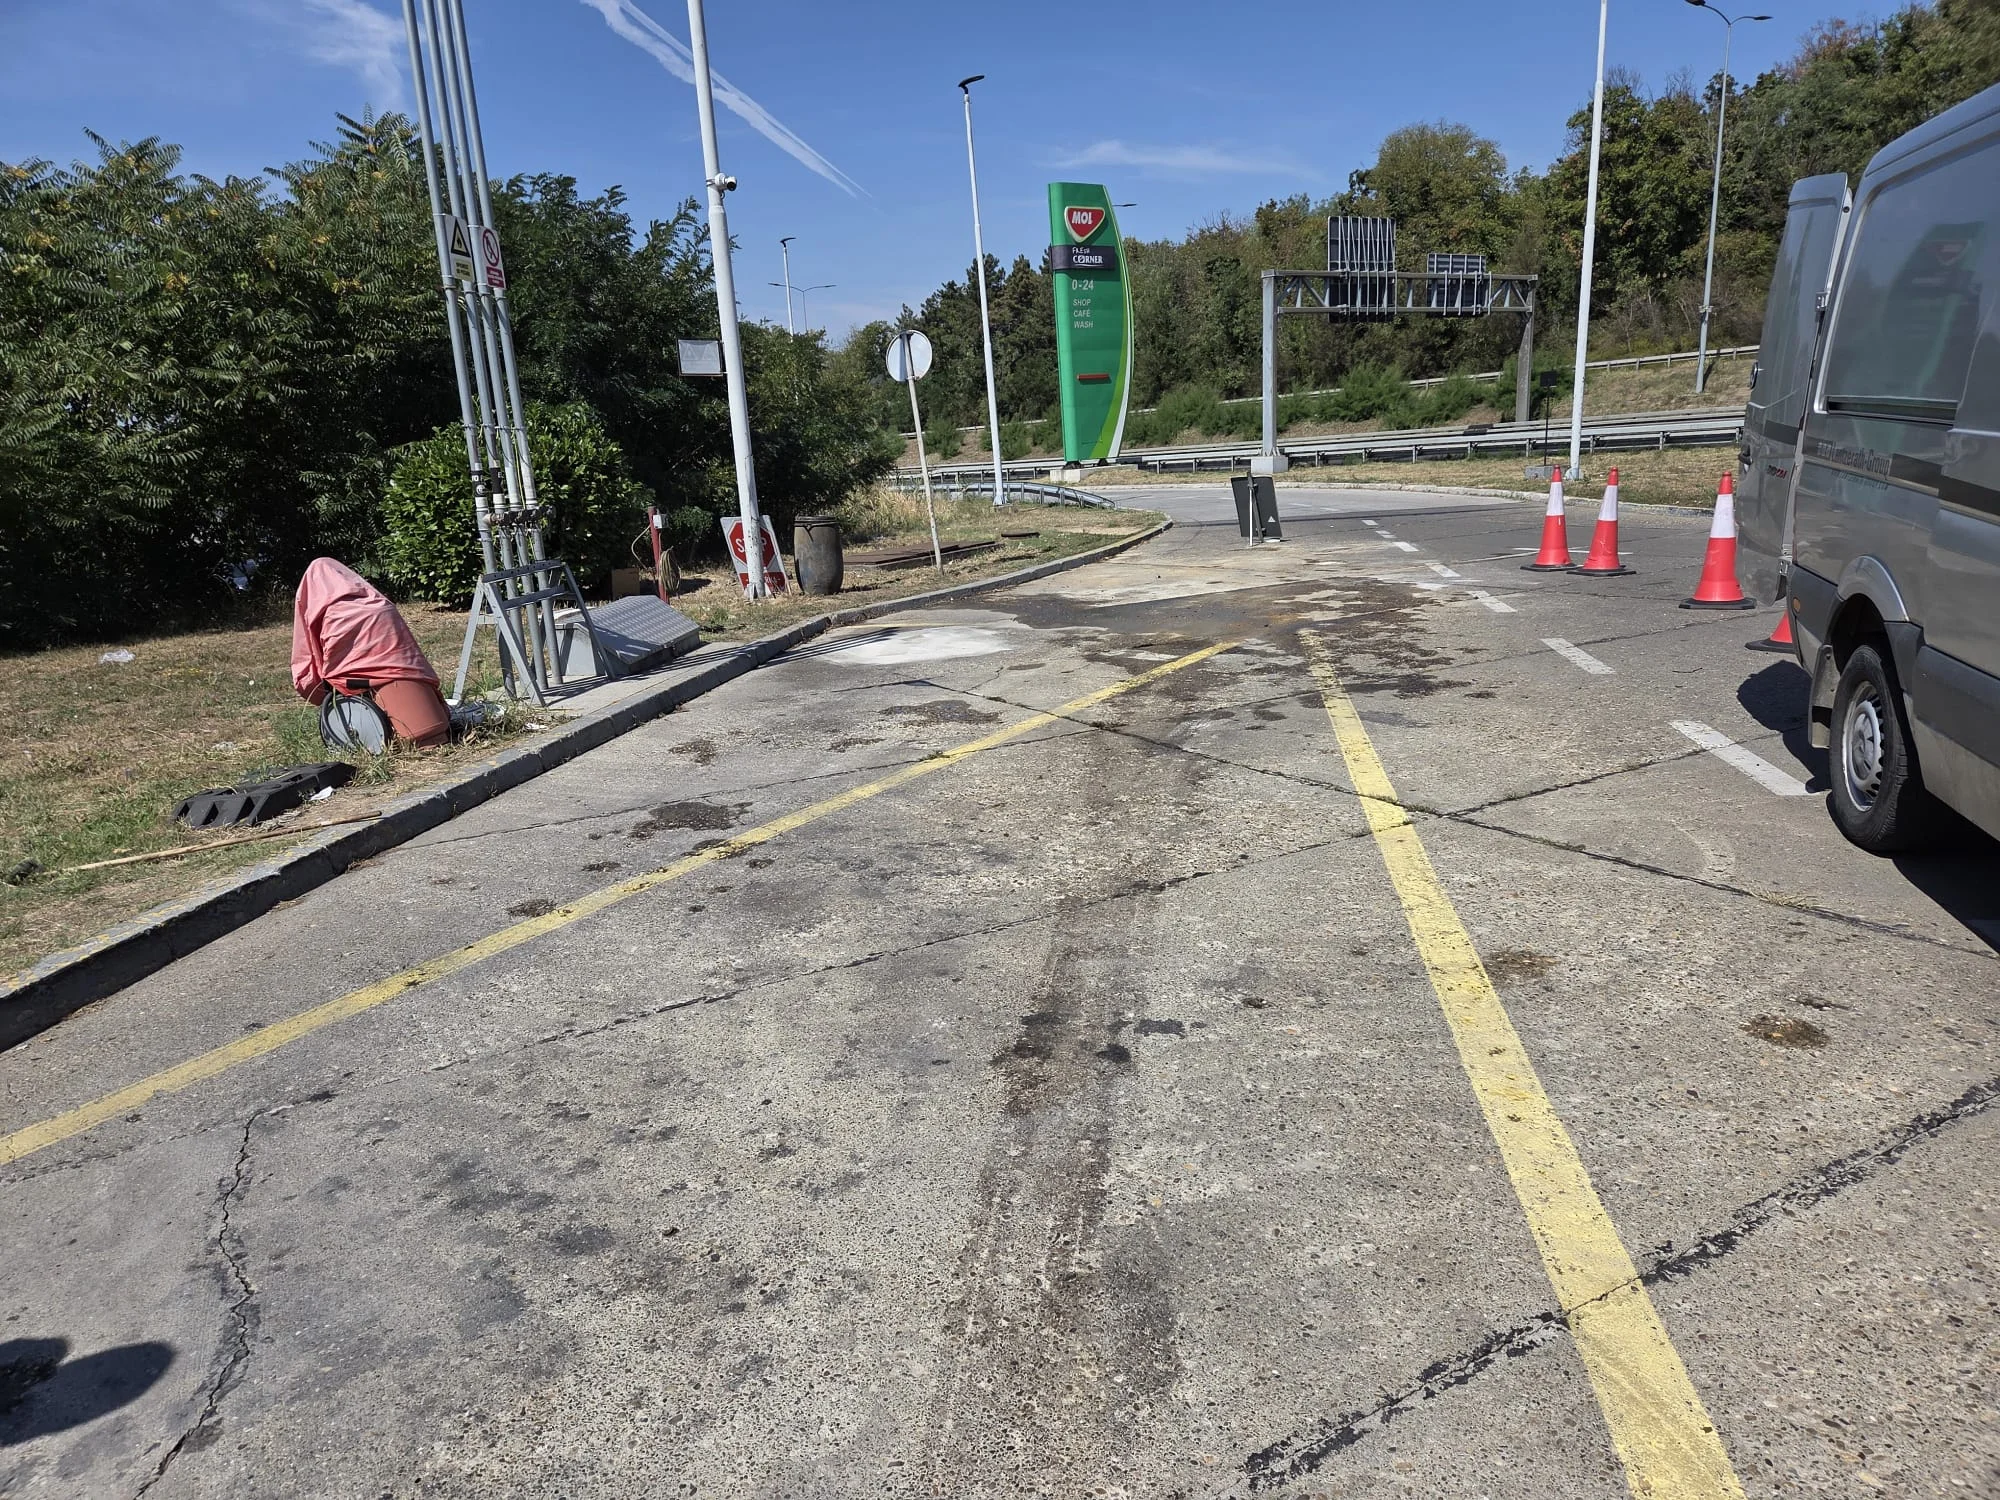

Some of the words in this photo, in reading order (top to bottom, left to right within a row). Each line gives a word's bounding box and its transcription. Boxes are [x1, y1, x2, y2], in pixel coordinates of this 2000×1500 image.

[1071, 211, 1093, 224] MOL
[1072, 255, 1103, 264] CORNER
[1072, 279, 1094, 291] 0-24
[1073, 298, 1091, 306] SHOP
[1074, 320, 1094, 329] WASH
[735, 537, 767, 553] SP
